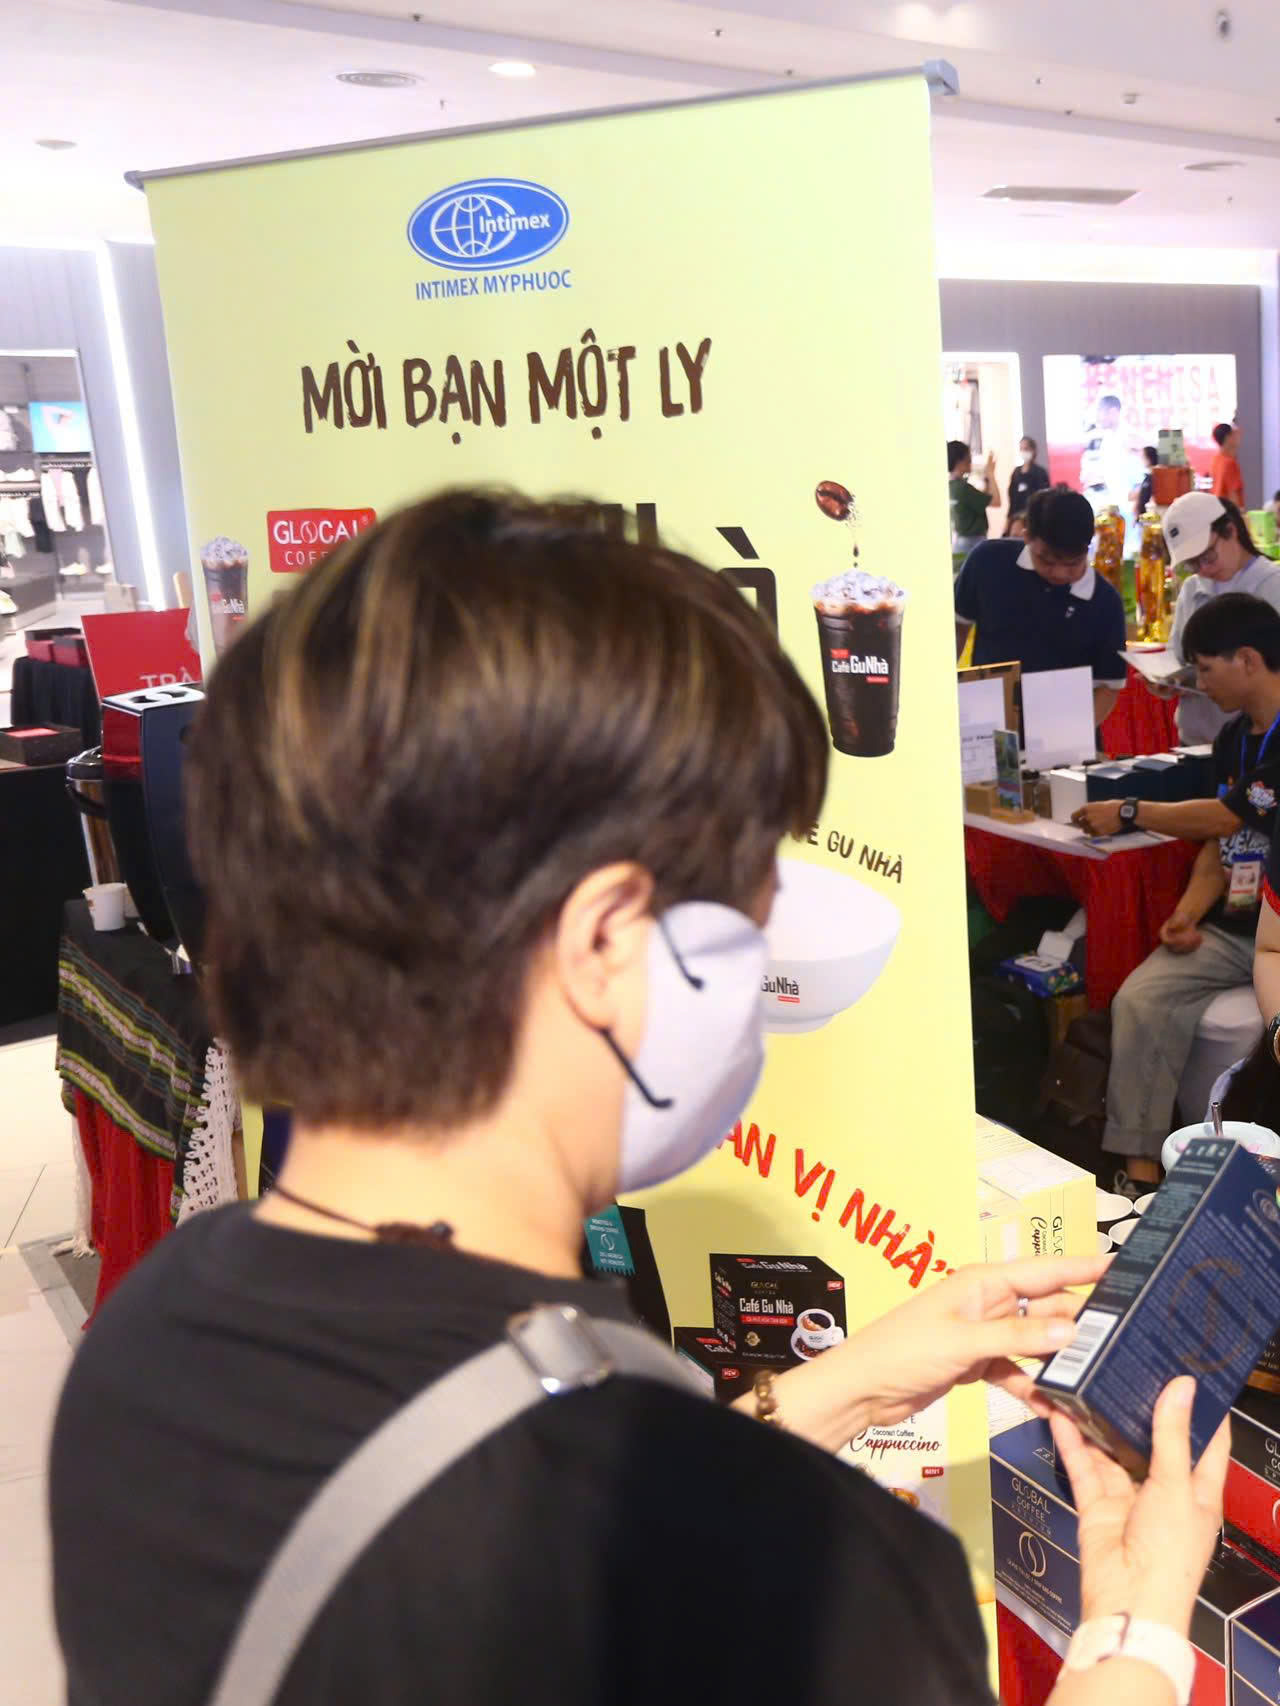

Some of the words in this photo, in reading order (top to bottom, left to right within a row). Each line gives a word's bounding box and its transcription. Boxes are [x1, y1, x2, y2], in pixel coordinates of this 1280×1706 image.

[479, 211, 551, 233] Intimex
[415, 276, 479, 300] INTIMEX
[483, 269, 573, 295] MYPHUOC
[301, 339, 388, 434] MỜI
[402, 354, 507, 445] BẠN
[525, 327, 637, 440] MỘT
[659, 337, 712, 418] LY
[831, 660, 850, 674] Café
[827, 830, 855, 858] GU
[858, 845, 903, 884] NHÀ
[793, 1148, 836, 1222] VỊ
[739, 1298, 760, 1313] Café
[761, 1299, 774, 1314] Gu
[776, 1299, 794, 1315] Nhà
[850, 1428, 940, 1460] Cappuccino
[1016, 1496, 1046, 1523] COFFEE
